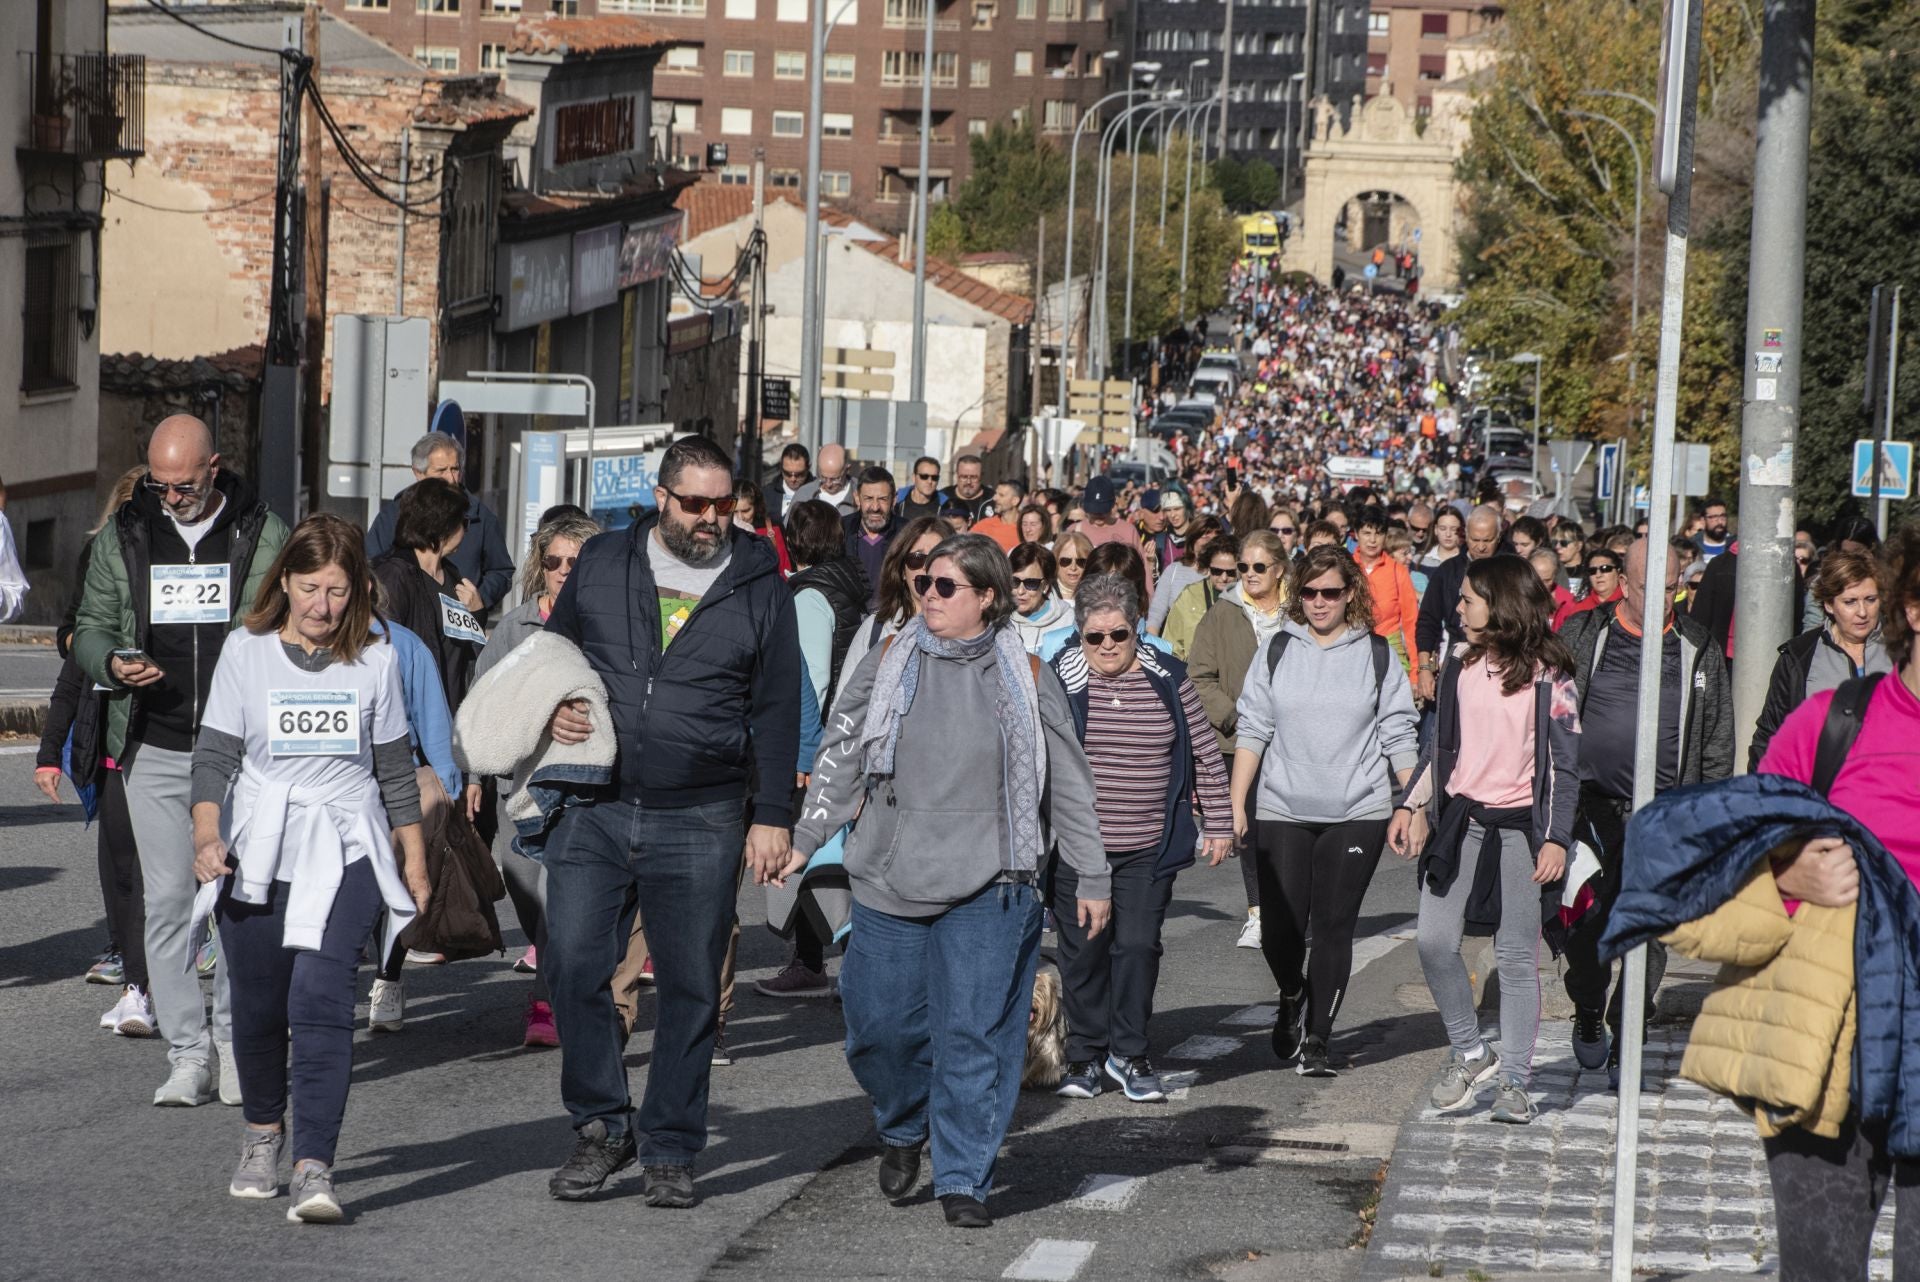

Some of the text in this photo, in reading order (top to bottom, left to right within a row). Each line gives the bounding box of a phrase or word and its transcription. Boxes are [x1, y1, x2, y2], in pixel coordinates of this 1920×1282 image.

[594, 456, 646, 477] BLUE
[447, 609, 479, 631] 6366
[279, 710, 349, 734] 6626
[803, 712, 855, 820] STITCH
